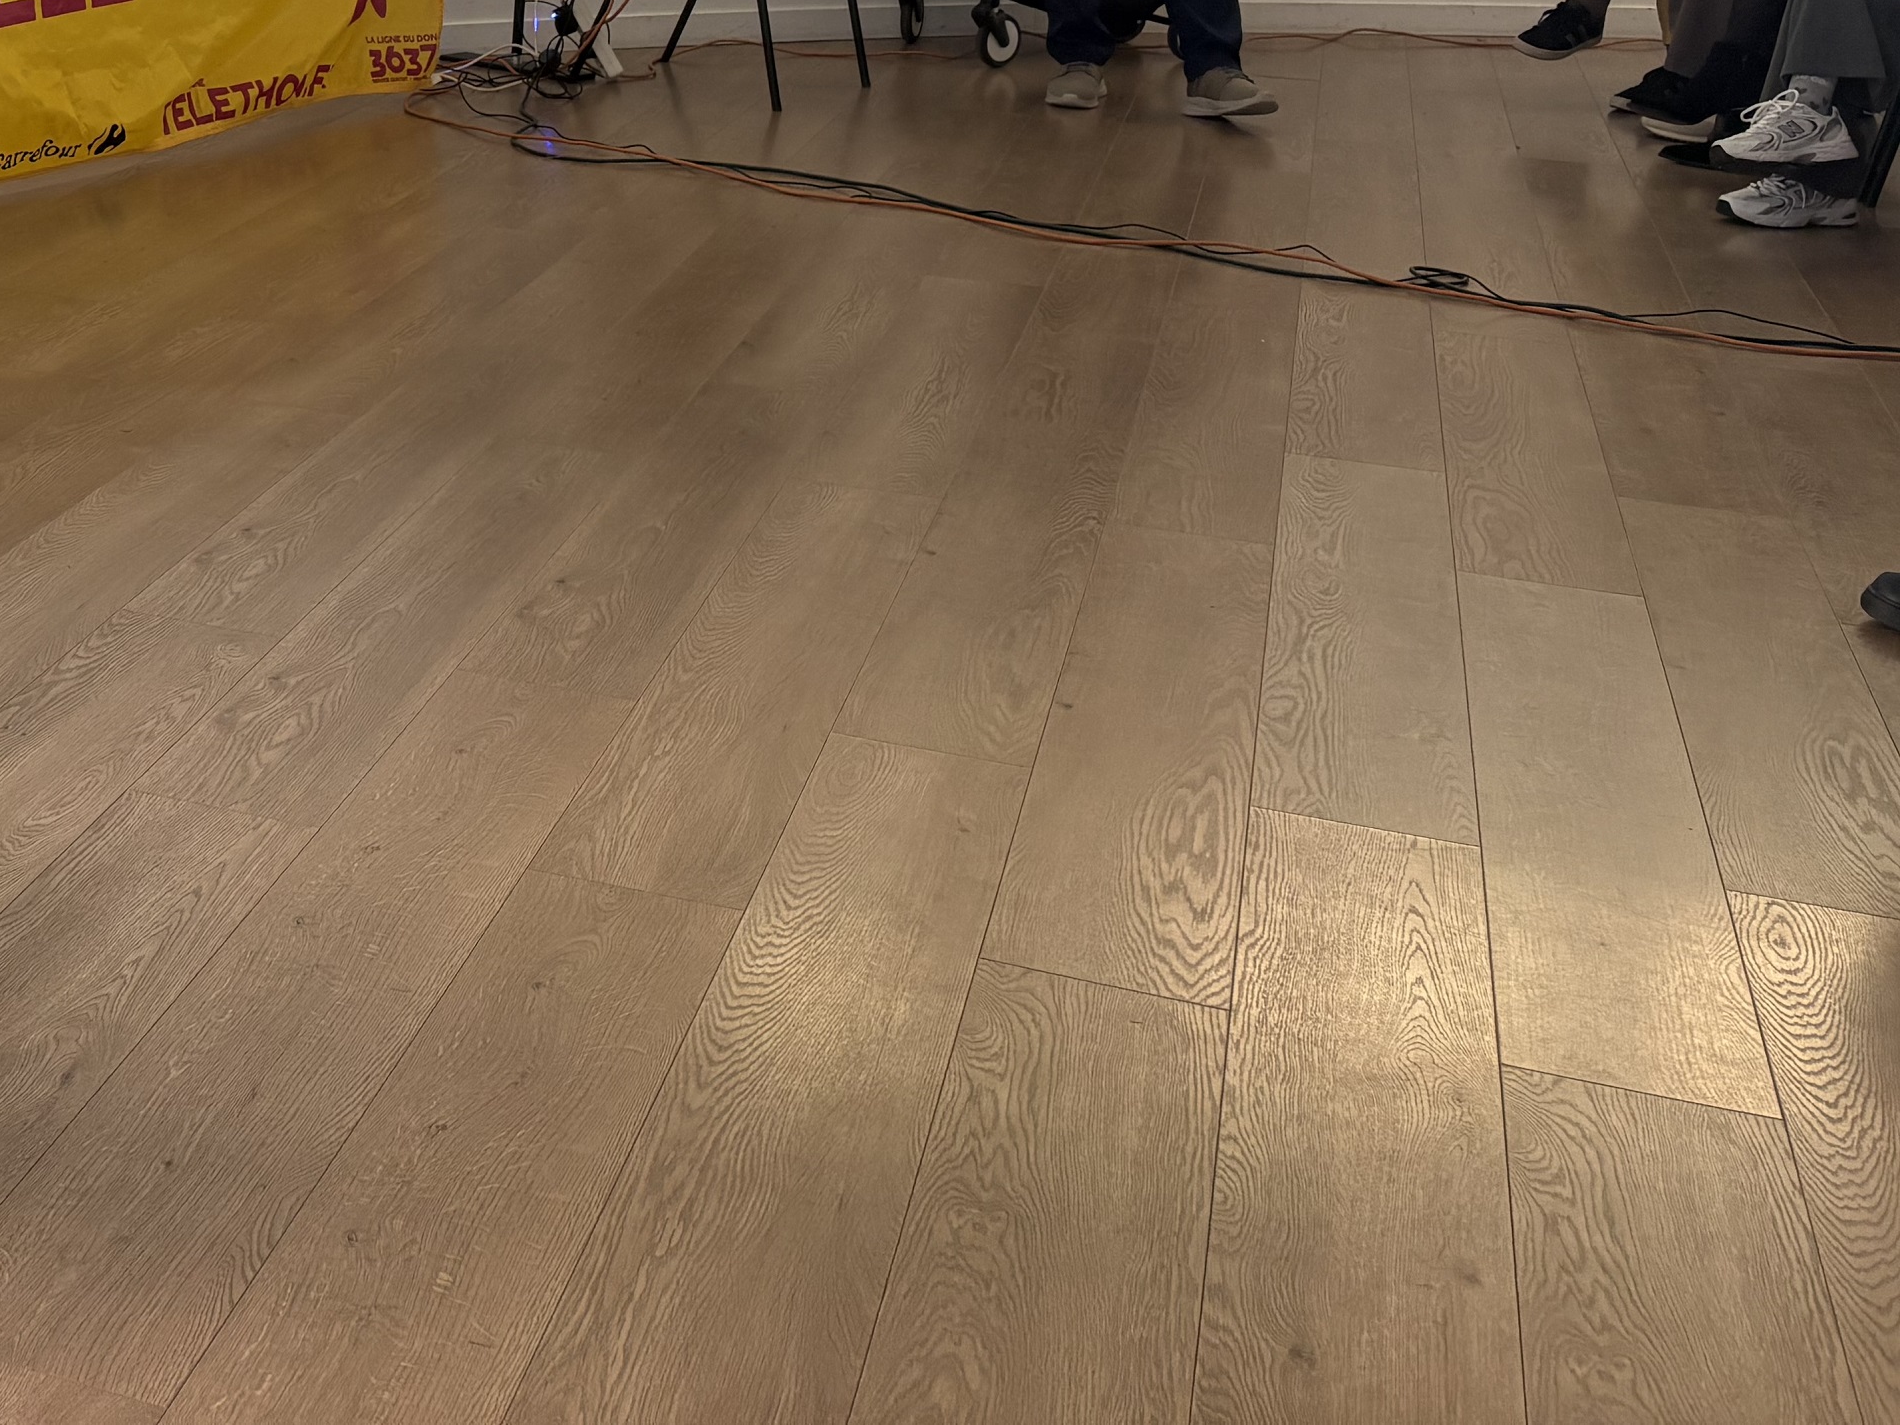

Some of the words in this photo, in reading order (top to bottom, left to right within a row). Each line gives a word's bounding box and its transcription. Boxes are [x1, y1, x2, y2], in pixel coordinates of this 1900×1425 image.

[403, 35, 414, 43] DU
[417, 33, 437, 43] DON
[369, 44, 437, 78] 3637
